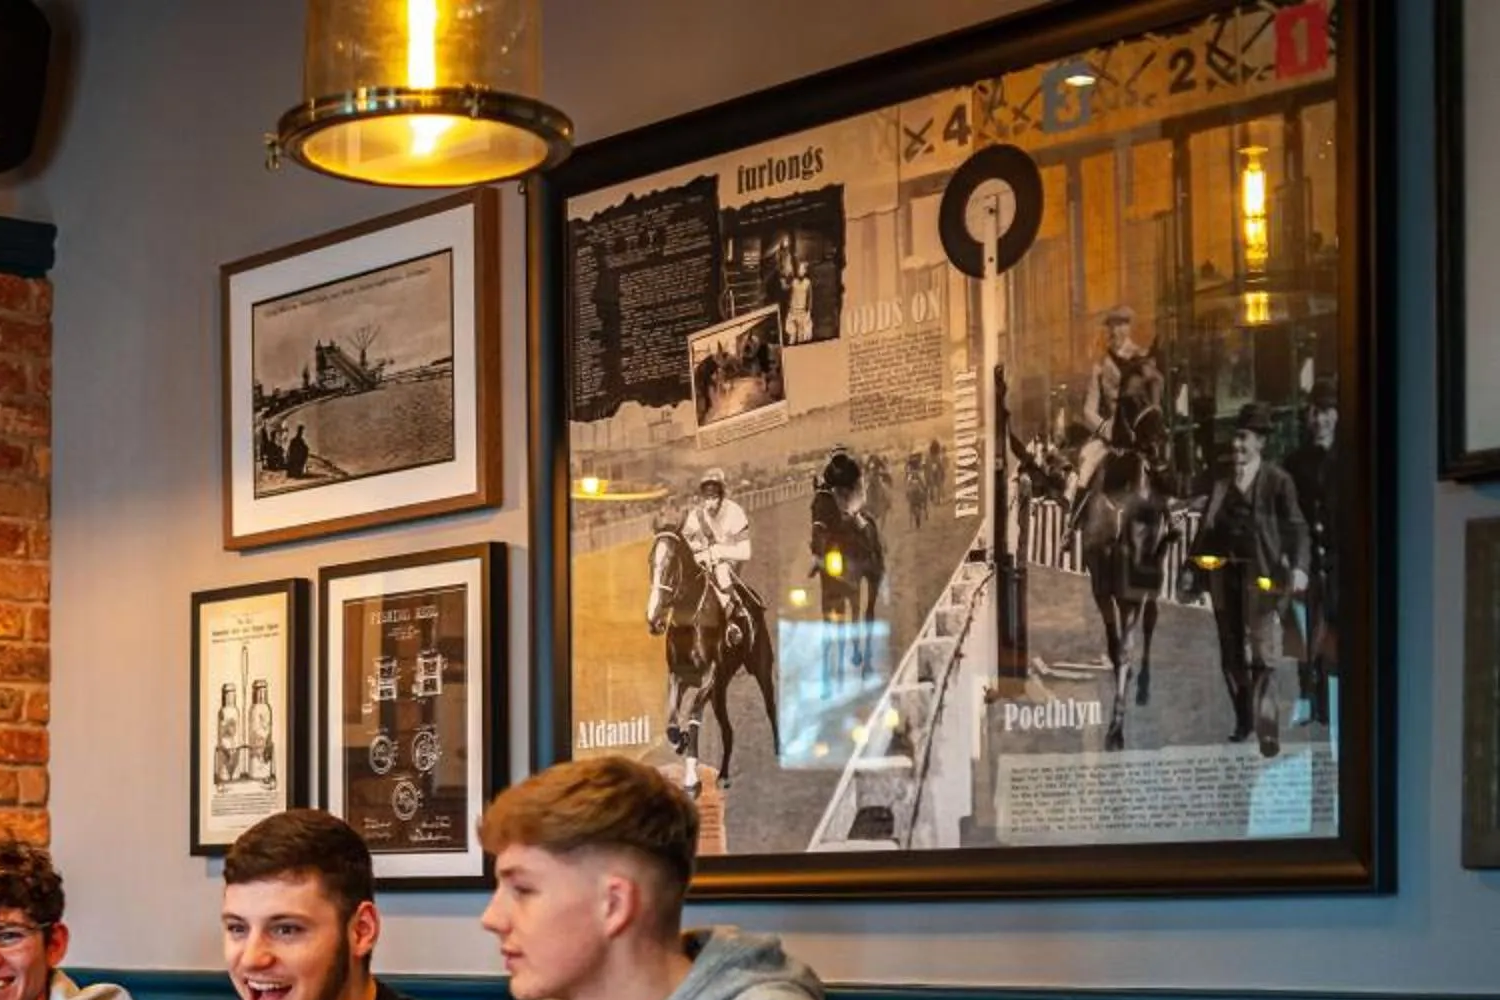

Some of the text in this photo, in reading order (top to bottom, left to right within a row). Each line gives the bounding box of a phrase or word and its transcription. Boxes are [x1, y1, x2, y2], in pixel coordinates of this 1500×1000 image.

[942, 103, 972, 147] 4
[1167, 48, 1197, 95] 2
[1289, 12, 1311, 66] 1
[736, 146, 825, 194] furlongs
[847, 289, 940, 337] ODDS ON
[953, 366, 979, 520] FAVOURITE
[1004, 699, 1102, 731] Poethlyn
